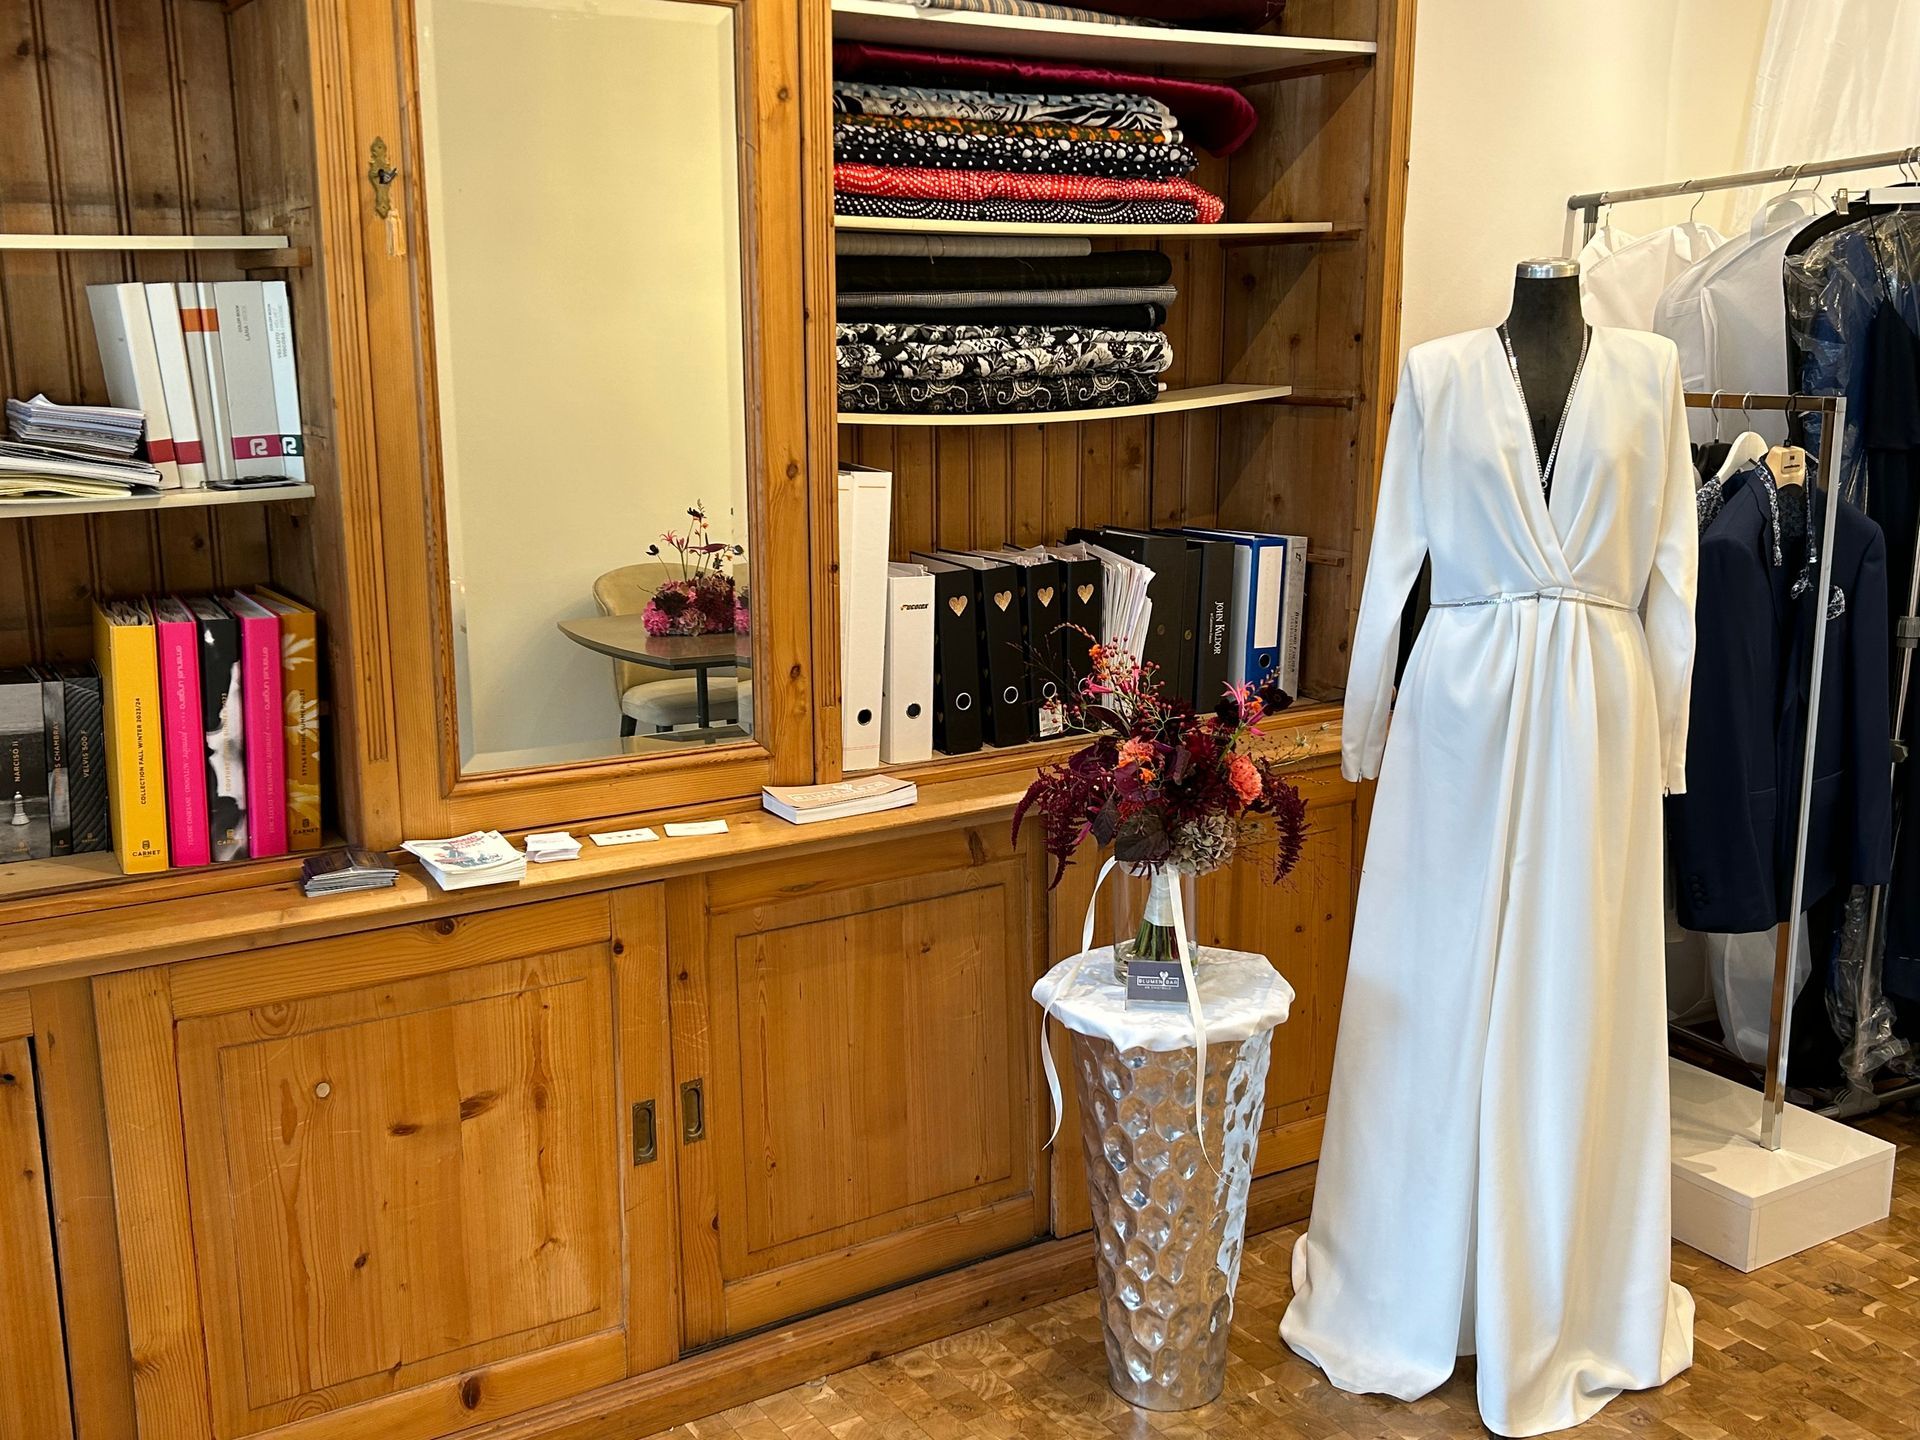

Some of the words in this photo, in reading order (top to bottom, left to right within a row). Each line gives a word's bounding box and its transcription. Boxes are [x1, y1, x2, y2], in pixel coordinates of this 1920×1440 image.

[243, 325, 251, 341] LANA
[1214, 600, 1224, 622] JOHN
[1213, 624, 1225, 655] KALDOR
[175, 645, 185, 679] emanuel
[262, 647, 270, 679] emanuel
[176, 680, 186, 709] ungaro
[262, 681, 271, 710] ungaro
[134, 697, 142, 723] 2023/24
[53, 720, 61, 762] CHAMBRAY
[81, 736, 89, 751] 500
[82, 752, 90, 778] VELVIS
[139, 766, 147, 805] COLLECTION
[292, 828, 319, 836] CARNET
